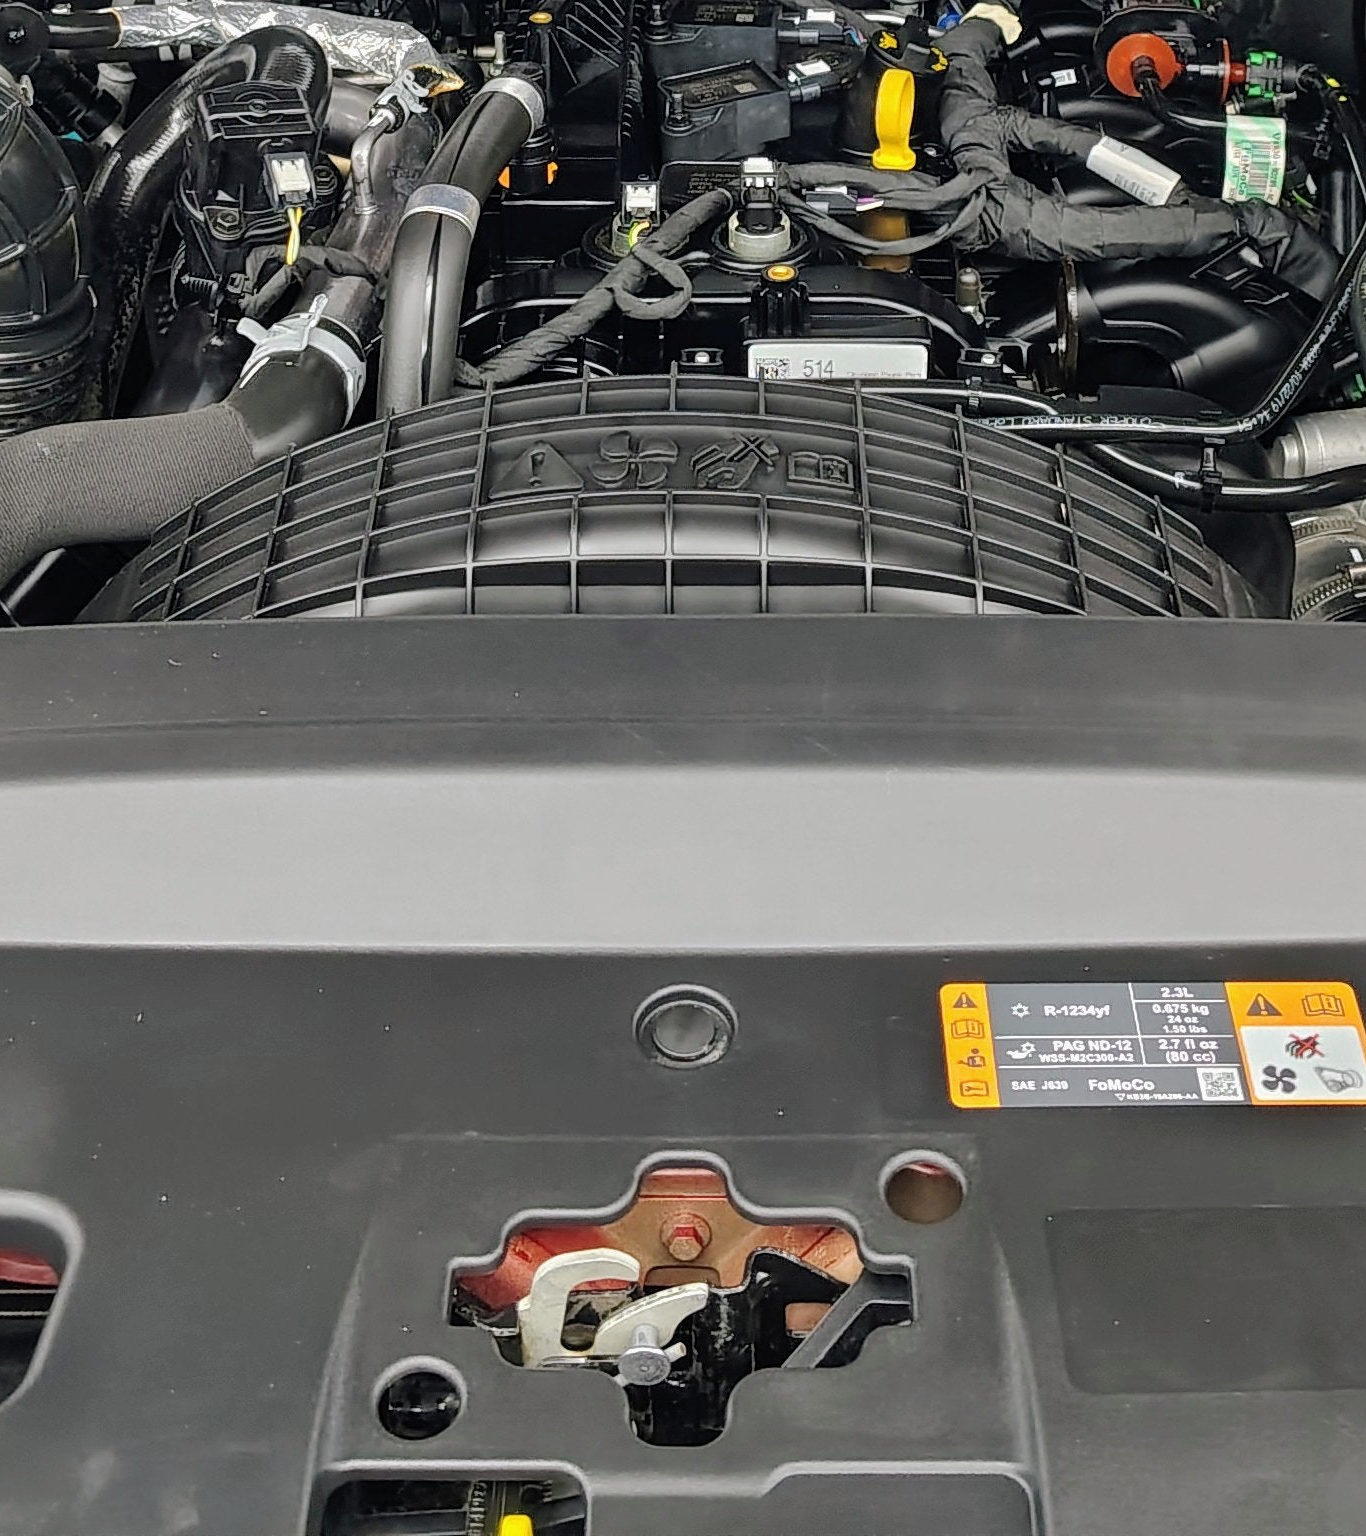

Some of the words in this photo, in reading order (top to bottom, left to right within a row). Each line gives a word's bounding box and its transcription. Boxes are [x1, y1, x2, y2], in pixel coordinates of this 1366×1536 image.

[803, 359, 835, 379] 514
[1160, 986, 1194, 999] 2.3L
[1043, 1004, 1110, 1019] R-1234yf
[1191, 1004, 1210, 1016] kg
[1167, 1015, 1182, 1024] 24
[1184, 1016, 1199, 1024] oz
[1189, 1025, 1208, 1034] lbs
[1053, 1040, 1085, 1052] PAG
[1087, 1039, 1133, 1052] ND-12
[1158, 1039, 1182, 1050] 2.7
[1184, 1039, 1196, 1050] fl
[1198, 1040, 1219, 1050] oz
[1165, 1051, 1190, 1064] (80
[1192, 1051, 1216, 1064] cc)
[1011, 1080, 1036, 1091] SAE
[1088, 1078, 1155, 1092] FoMoCo
